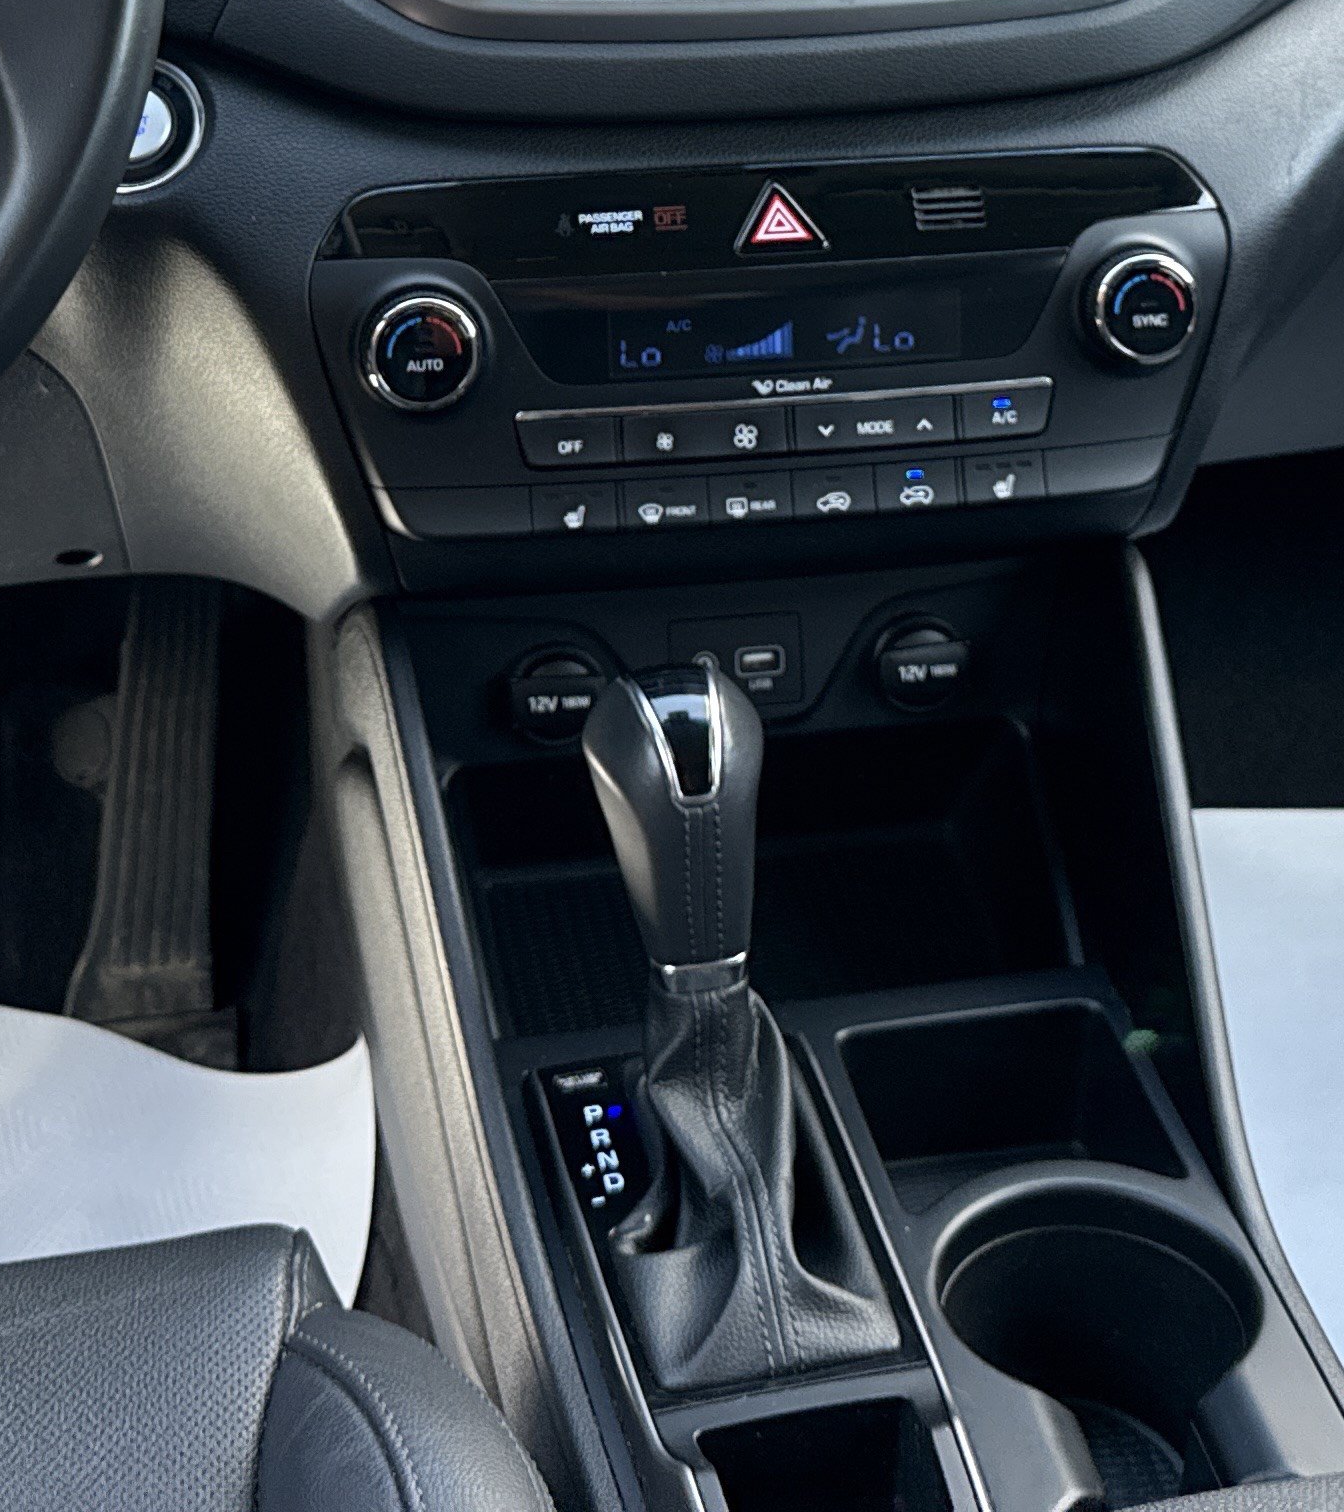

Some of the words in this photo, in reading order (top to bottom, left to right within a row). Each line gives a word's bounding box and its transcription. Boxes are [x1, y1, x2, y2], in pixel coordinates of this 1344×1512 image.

[578, 209, 643, 225] PASSENGER
[591, 223, 610, 234] AIR
[610, 221, 635, 234] BAG
[666, 319, 693, 334] A/C
[1131, 313, 1170, 330] SYNC
[406, 357, 444, 374] AUTO
[775, 379, 810, 392] Clean
[812, 377, 833, 390] Air
[991, 411, 1018, 425] A/C
[857, 420, 894, 436] MODE
[557, 439, 584, 455] OFF
[897, 664, 928, 683] 12V
[529, 694, 559, 714] 12V
[583, 1104, 603, 1127] P
[590, 1128, 612, 1150] R
[597, 1149, 620, 1172] N
[603, 1172, 625, 1195] D
